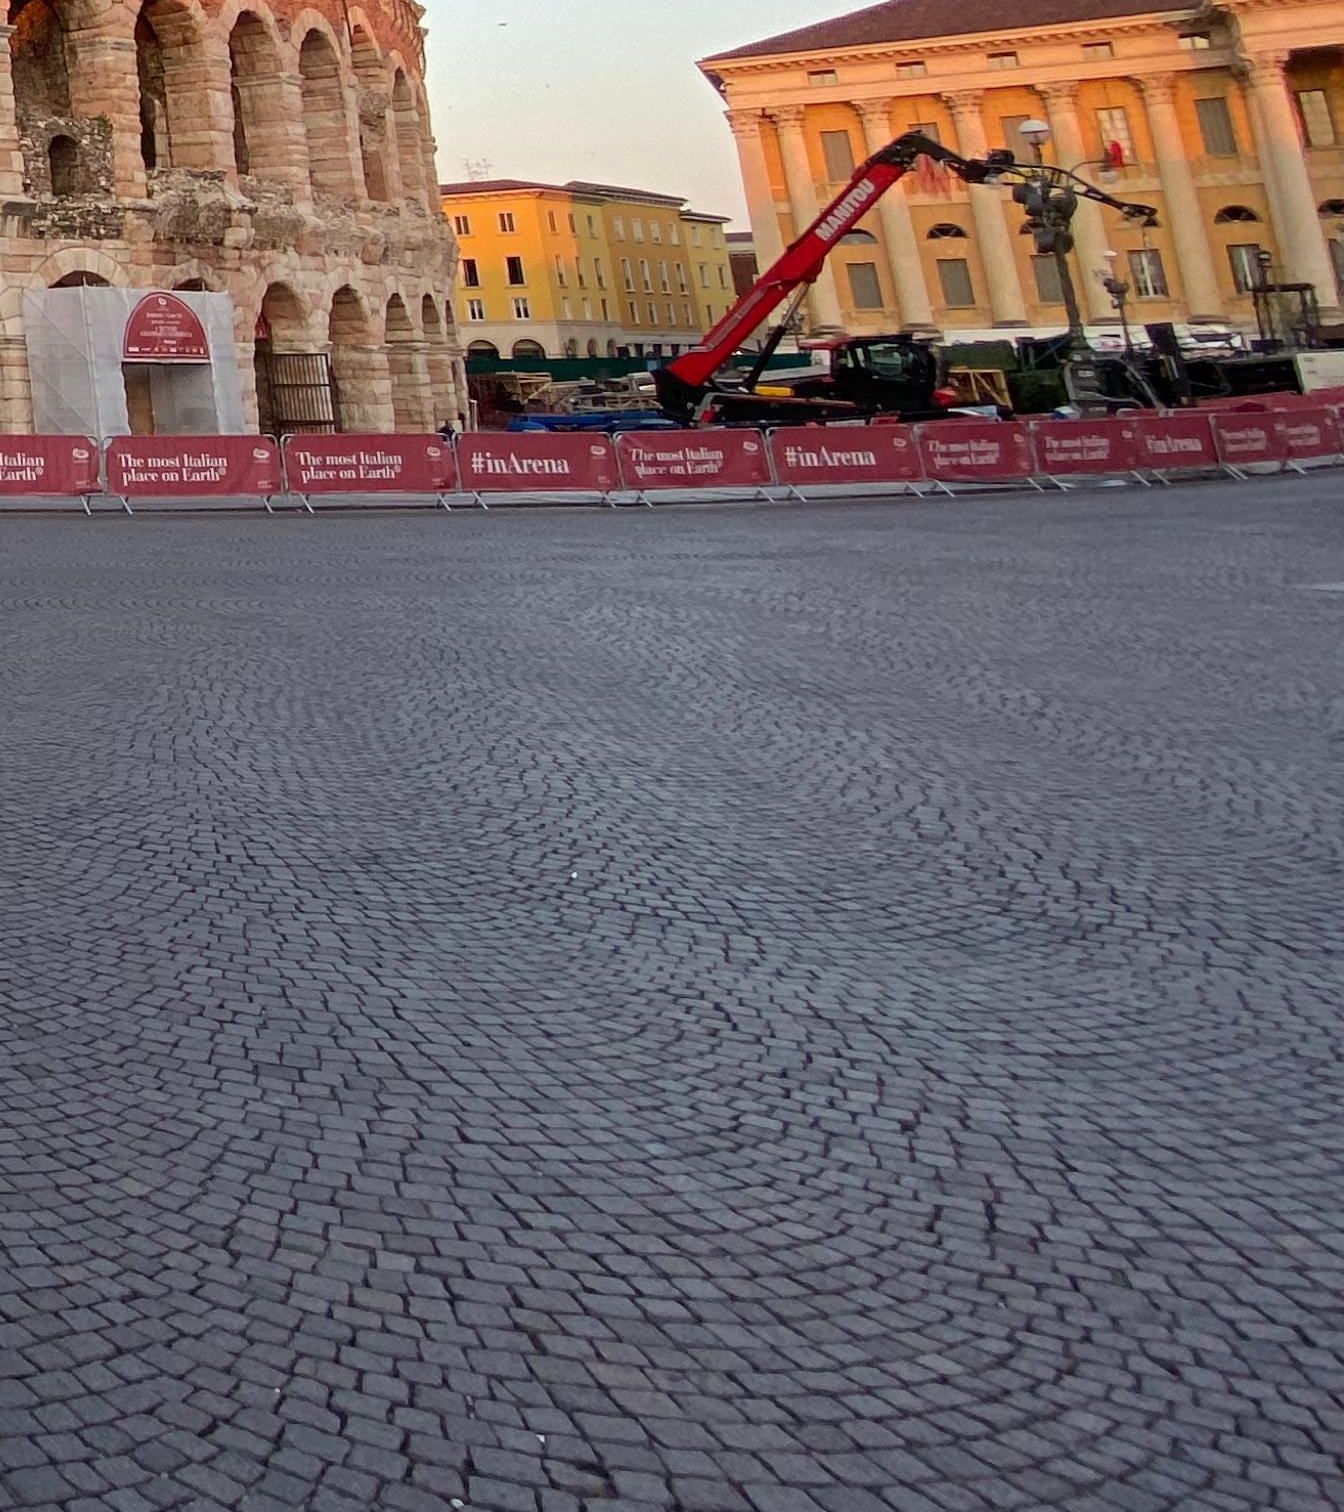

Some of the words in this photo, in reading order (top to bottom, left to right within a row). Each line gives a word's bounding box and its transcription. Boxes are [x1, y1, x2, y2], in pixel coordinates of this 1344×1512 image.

[815, 178, 875, 241] MANITOU
[117, 453, 145, 468] The
[148, 455, 180, 468] most
[184, 454, 227, 468] Italian
[296, 451, 323, 465] The
[326, 453, 357, 466] most
[361, 451, 402, 466] Italian
[472, 451, 571, 475] #inArena
[784, 446, 877, 467] #inArena
[122, 468, 159, 486] place
[161, 471, 179, 482] on
[301, 466, 337, 484] place
[339, 469, 356, 479] on
